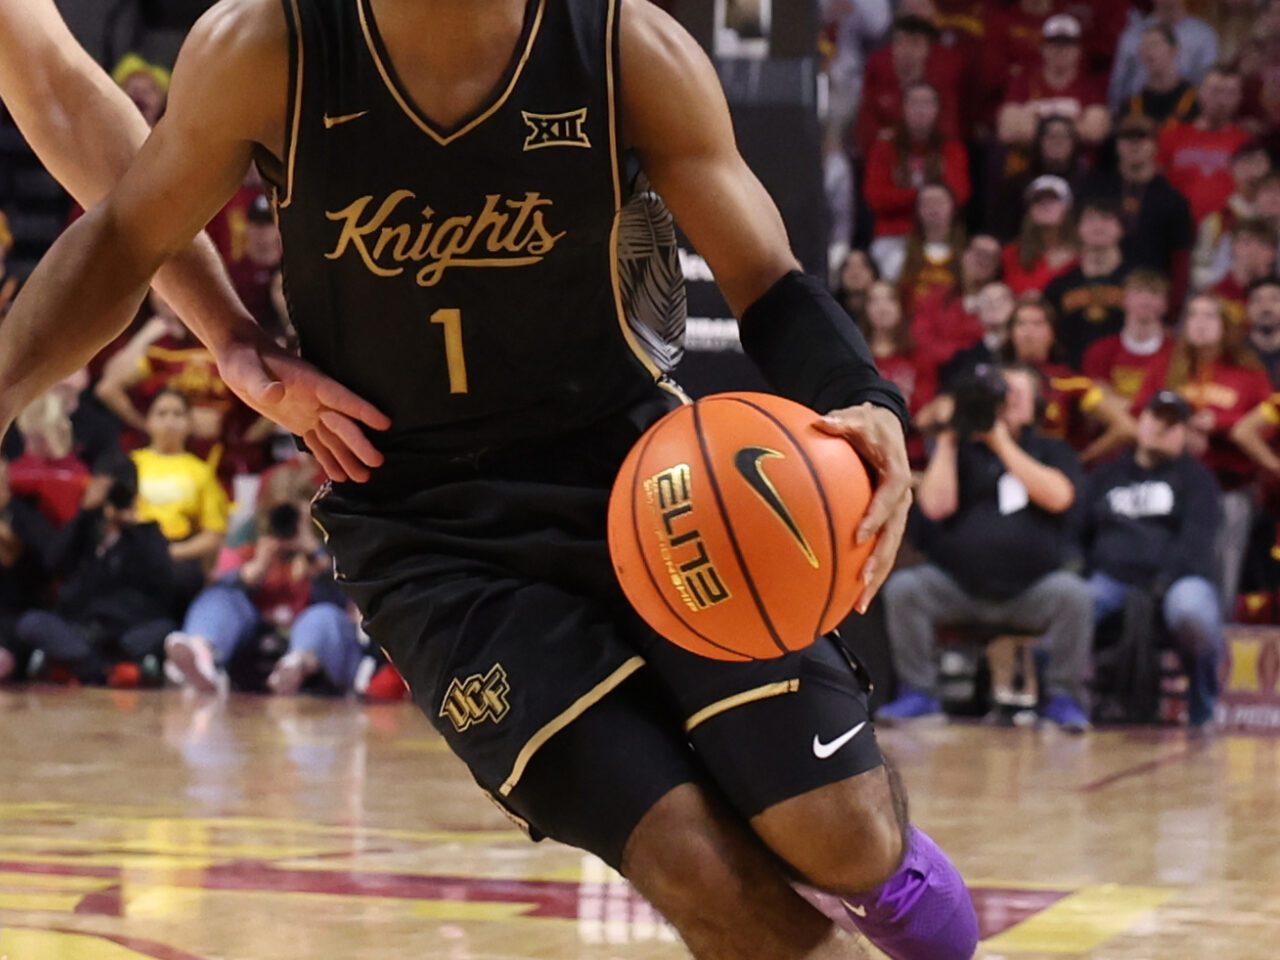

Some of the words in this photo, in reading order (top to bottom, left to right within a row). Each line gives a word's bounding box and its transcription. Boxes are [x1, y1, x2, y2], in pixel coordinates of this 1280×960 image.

[521, 107, 592, 151] XII
[324, 189, 567, 287] Knights
[430, 308, 468, 394] 1
[653, 462, 733, 610] ELITE
[439, 662, 511, 733] UCF
